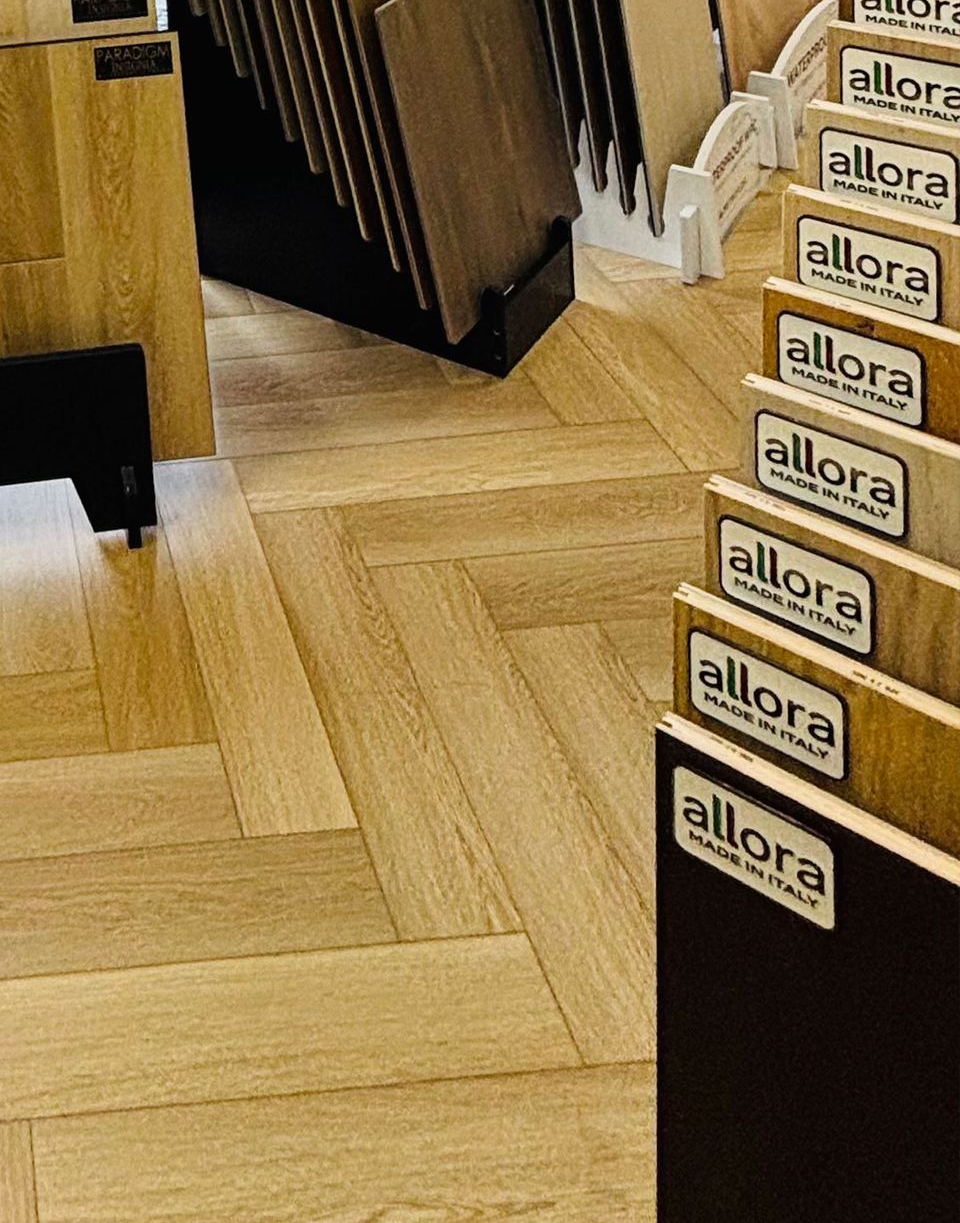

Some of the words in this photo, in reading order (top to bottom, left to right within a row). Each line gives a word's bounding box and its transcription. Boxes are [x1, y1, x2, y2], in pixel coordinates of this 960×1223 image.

[866, 15, 908, 28] MADE
[910, 22, 926, 31] IN
[96, 45, 170, 61] PARADIGM
[849, 61, 960, 109] allora
[854, 94, 897, 110] MADE
[900, 104, 916, 114] IN
[829, 144, 948, 198] allora
[833, 179, 877, 196] MADE
[881, 189, 898, 201] IN
[900, 194, 944, 210] ITALY
[806, 233, 929, 295] allora
[811, 268, 857, 288] MADE
[860, 282, 877, 294] IN
[880, 288, 924, 306] ITALY
[786, 331, 914, 399] allora
[792, 366, 840, 390] MADE
[842, 382, 859, 396] IN
[863, 389, 908, 411] ITALY
[765, 432, 896, 508] allora
[770, 468, 818, 494] MADE
[823, 486, 840, 502] IN
[843, 495, 890, 520] ITALY
[728, 541, 862, 623] allora
[734, 576, 784, 603] MADE
[788, 597, 805, 614] IN
[809, 609, 856, 636] ITALY
[699, 656, 835, 749] allora
[703, 691, 755, 724] MADE
[758, 717, 777, 736] IN
[780, 729, 829, 761] ITALY
[682, 793, 825, 897] allora
[688, 829, 740, 867] MADE
[744, 859, 764, 880] IN
[768, 873, 819, 909] ITALY
